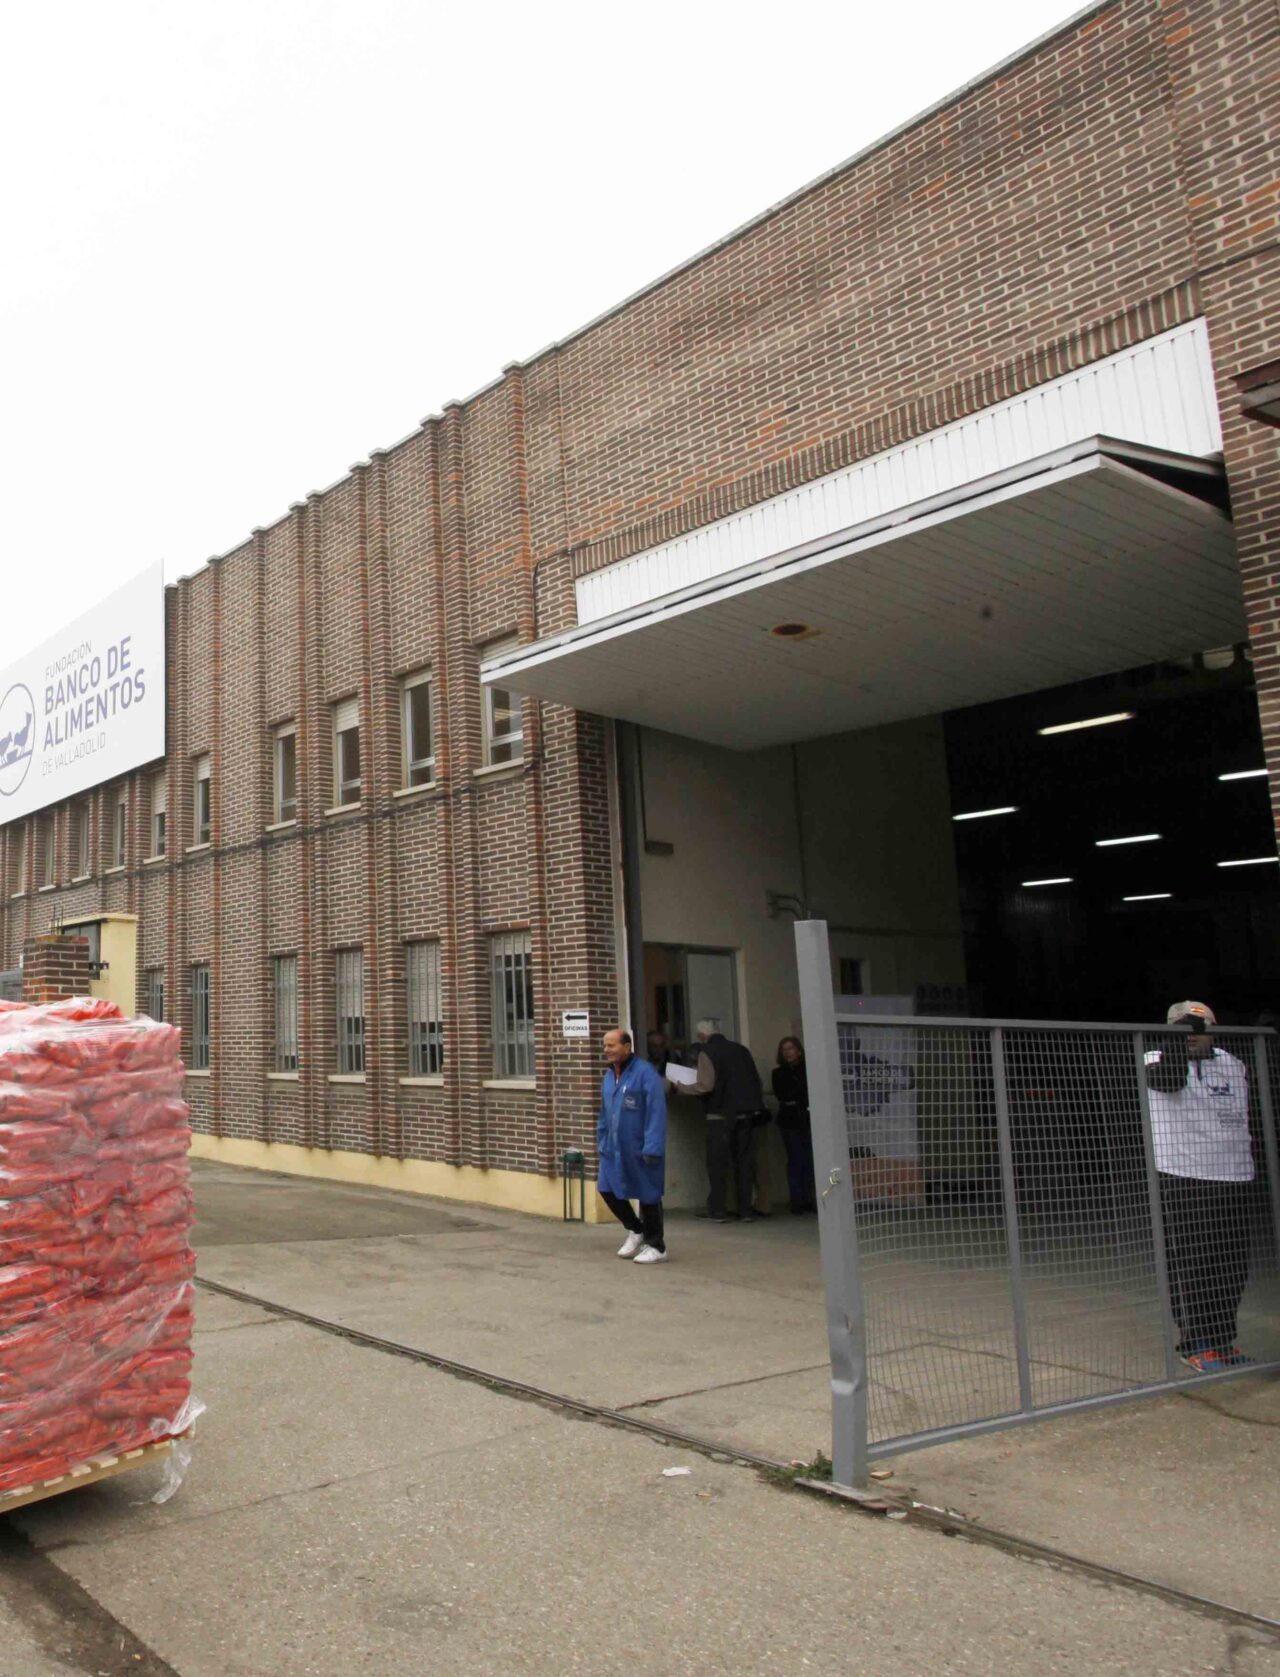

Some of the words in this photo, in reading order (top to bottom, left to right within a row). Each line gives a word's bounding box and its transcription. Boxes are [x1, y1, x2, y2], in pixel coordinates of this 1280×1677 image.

[45, 640, 92, 681] FUNDACIÓN
[45, 656, 101, 716] BANCO
[107, 635, 131, 679] DE
[43, 668, 146, 752] ALIMENTOS
[42, 758, 52, 776] DE
[55, 731, 106, 770] VALLADOLID
